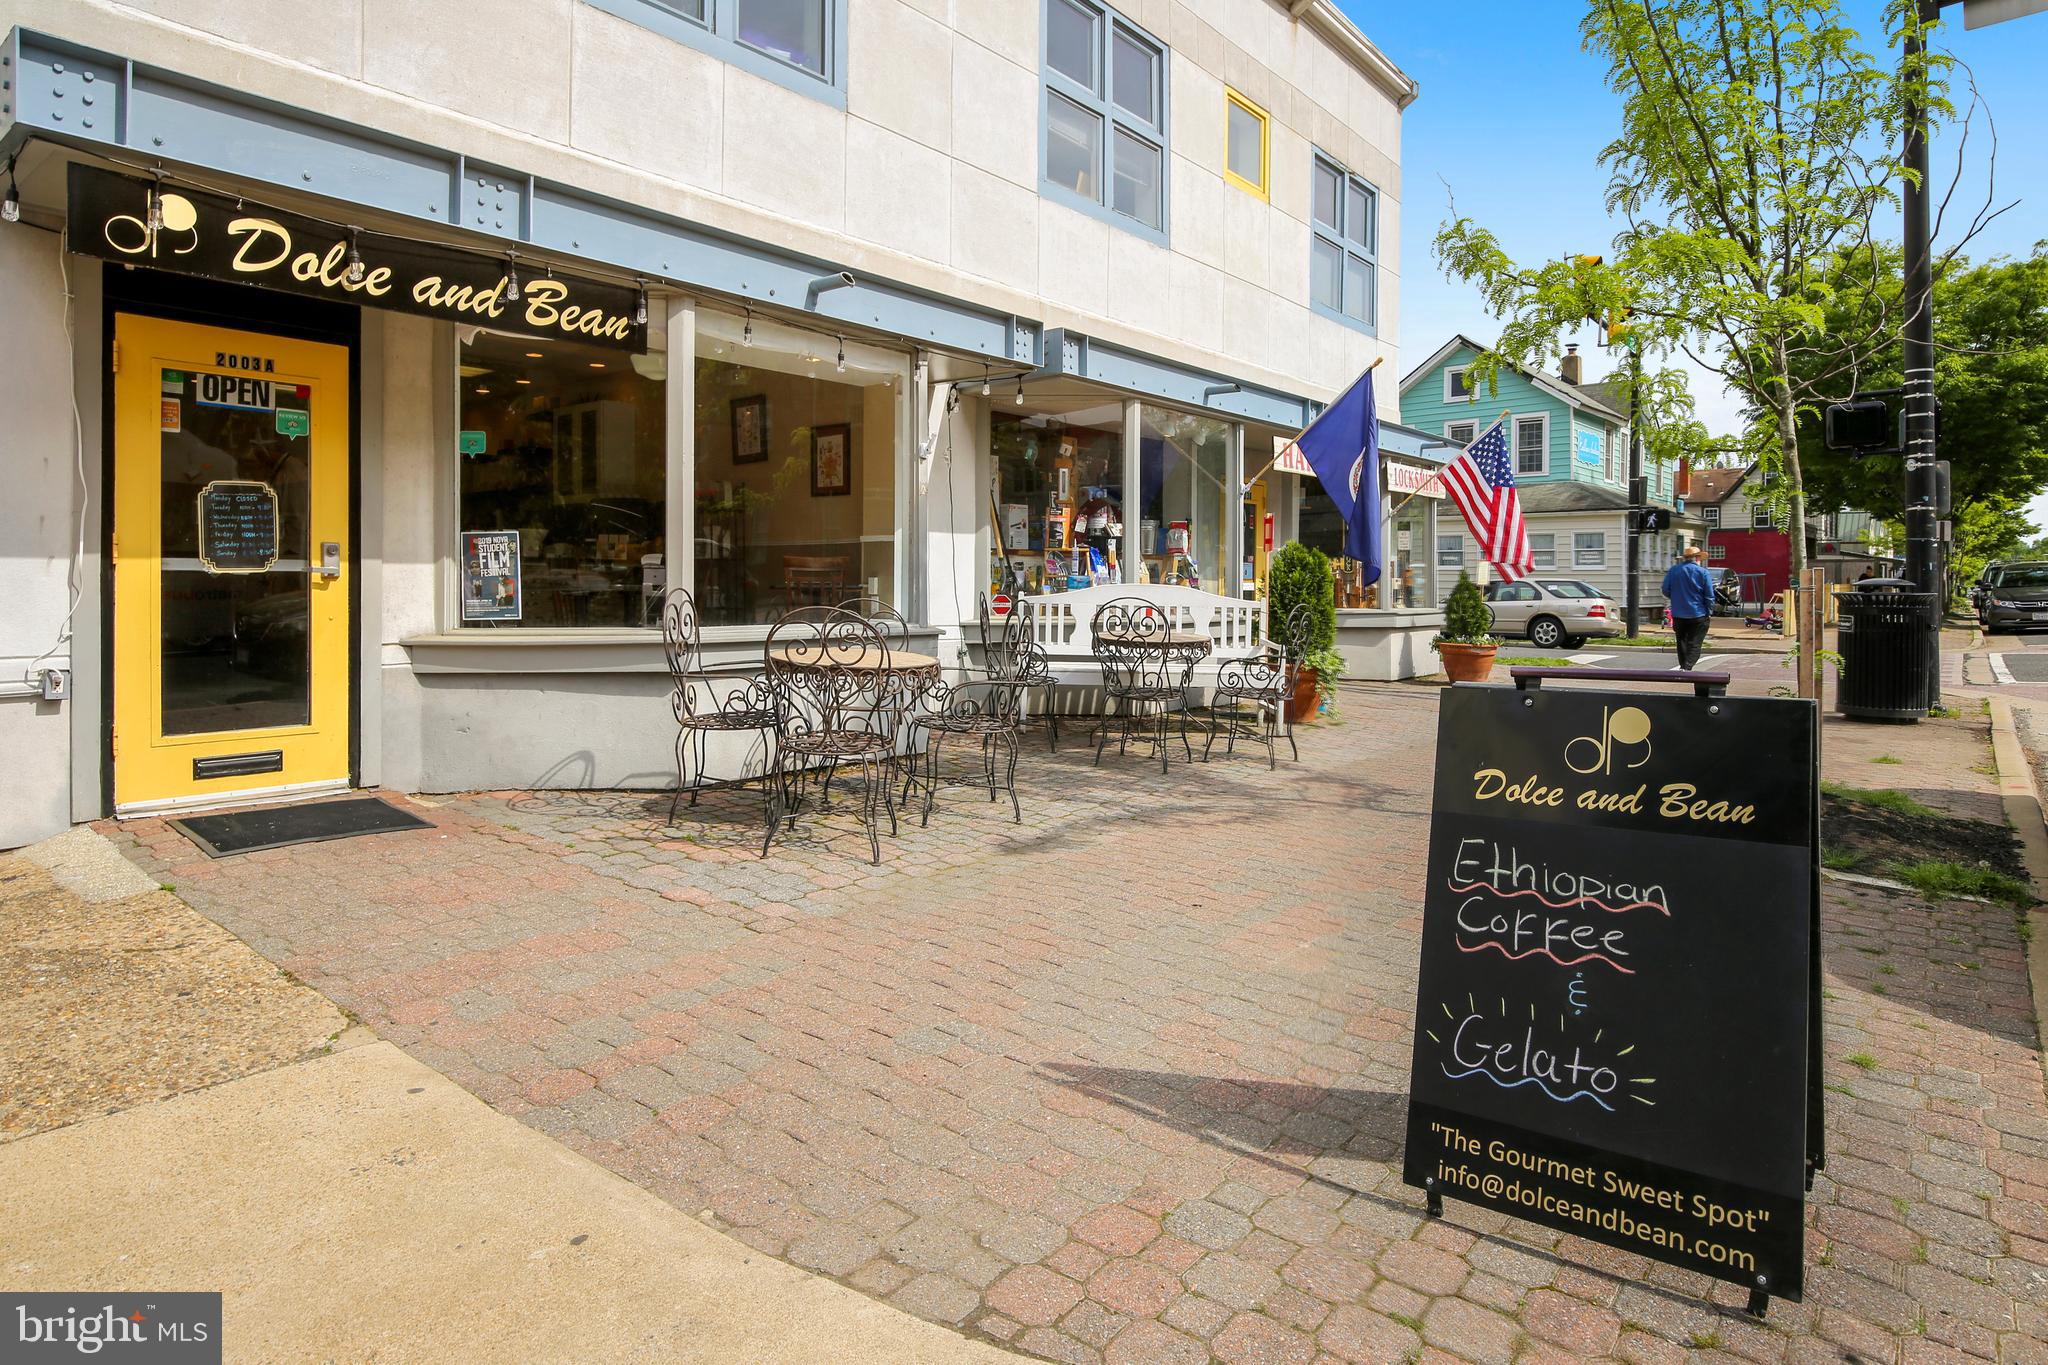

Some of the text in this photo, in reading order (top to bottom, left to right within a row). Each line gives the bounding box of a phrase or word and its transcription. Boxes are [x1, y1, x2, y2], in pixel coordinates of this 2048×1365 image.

[227, 217, 630, 340] Dolce and Bean
[216, 352, 275, 373] 2003A
[203, 375, 270, 408] OPEN
[1394, 467, 1439, 493] LOCKSMITH
[478, 543, 509, 553] STUDENT
[479, 551, 510, 569] FILM
[480, 567, 511, 577] FESTIVAL
[1473, 768, 1756, 824] Dolce and Bean
[1453, 838, 1668, 911] Ethiopian
[1453, 1015, 1617, 1092] Gelato
[1431, 1122, 1770, 1233] "The Gourmet Sweet Spot"
[1437, 1160, 1756, 1272] info@dolceandbean.com
